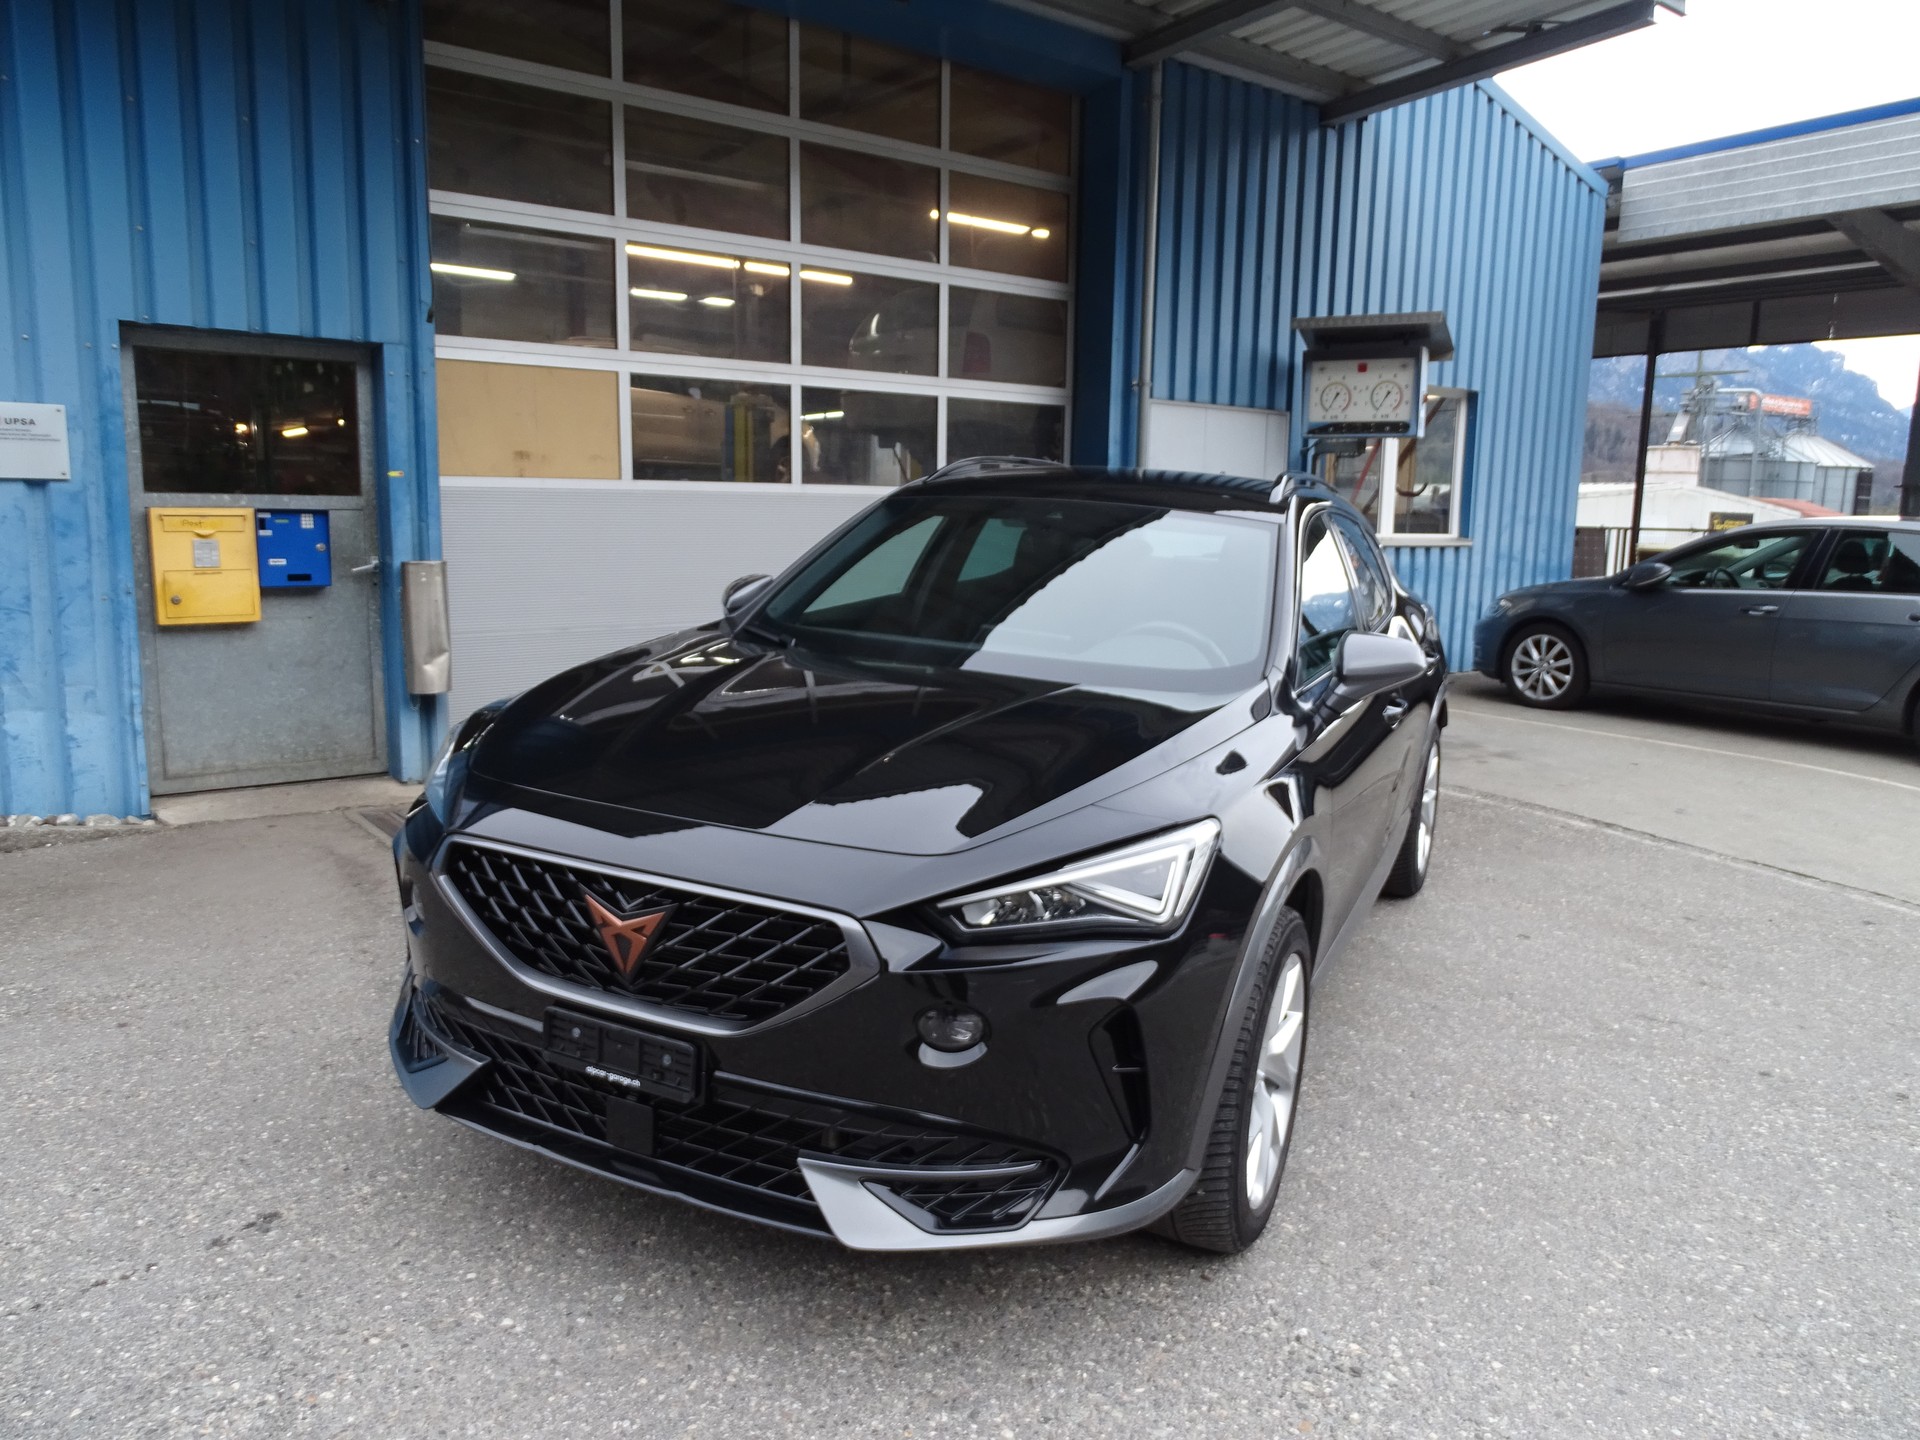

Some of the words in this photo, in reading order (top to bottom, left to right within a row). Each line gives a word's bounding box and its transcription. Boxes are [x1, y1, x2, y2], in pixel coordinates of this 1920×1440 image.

[4, 417, 36, 426] UPSA
[182, 519, 204, 528] Post
[585, 1066, 641, 1087] alpcar-garage.ch
